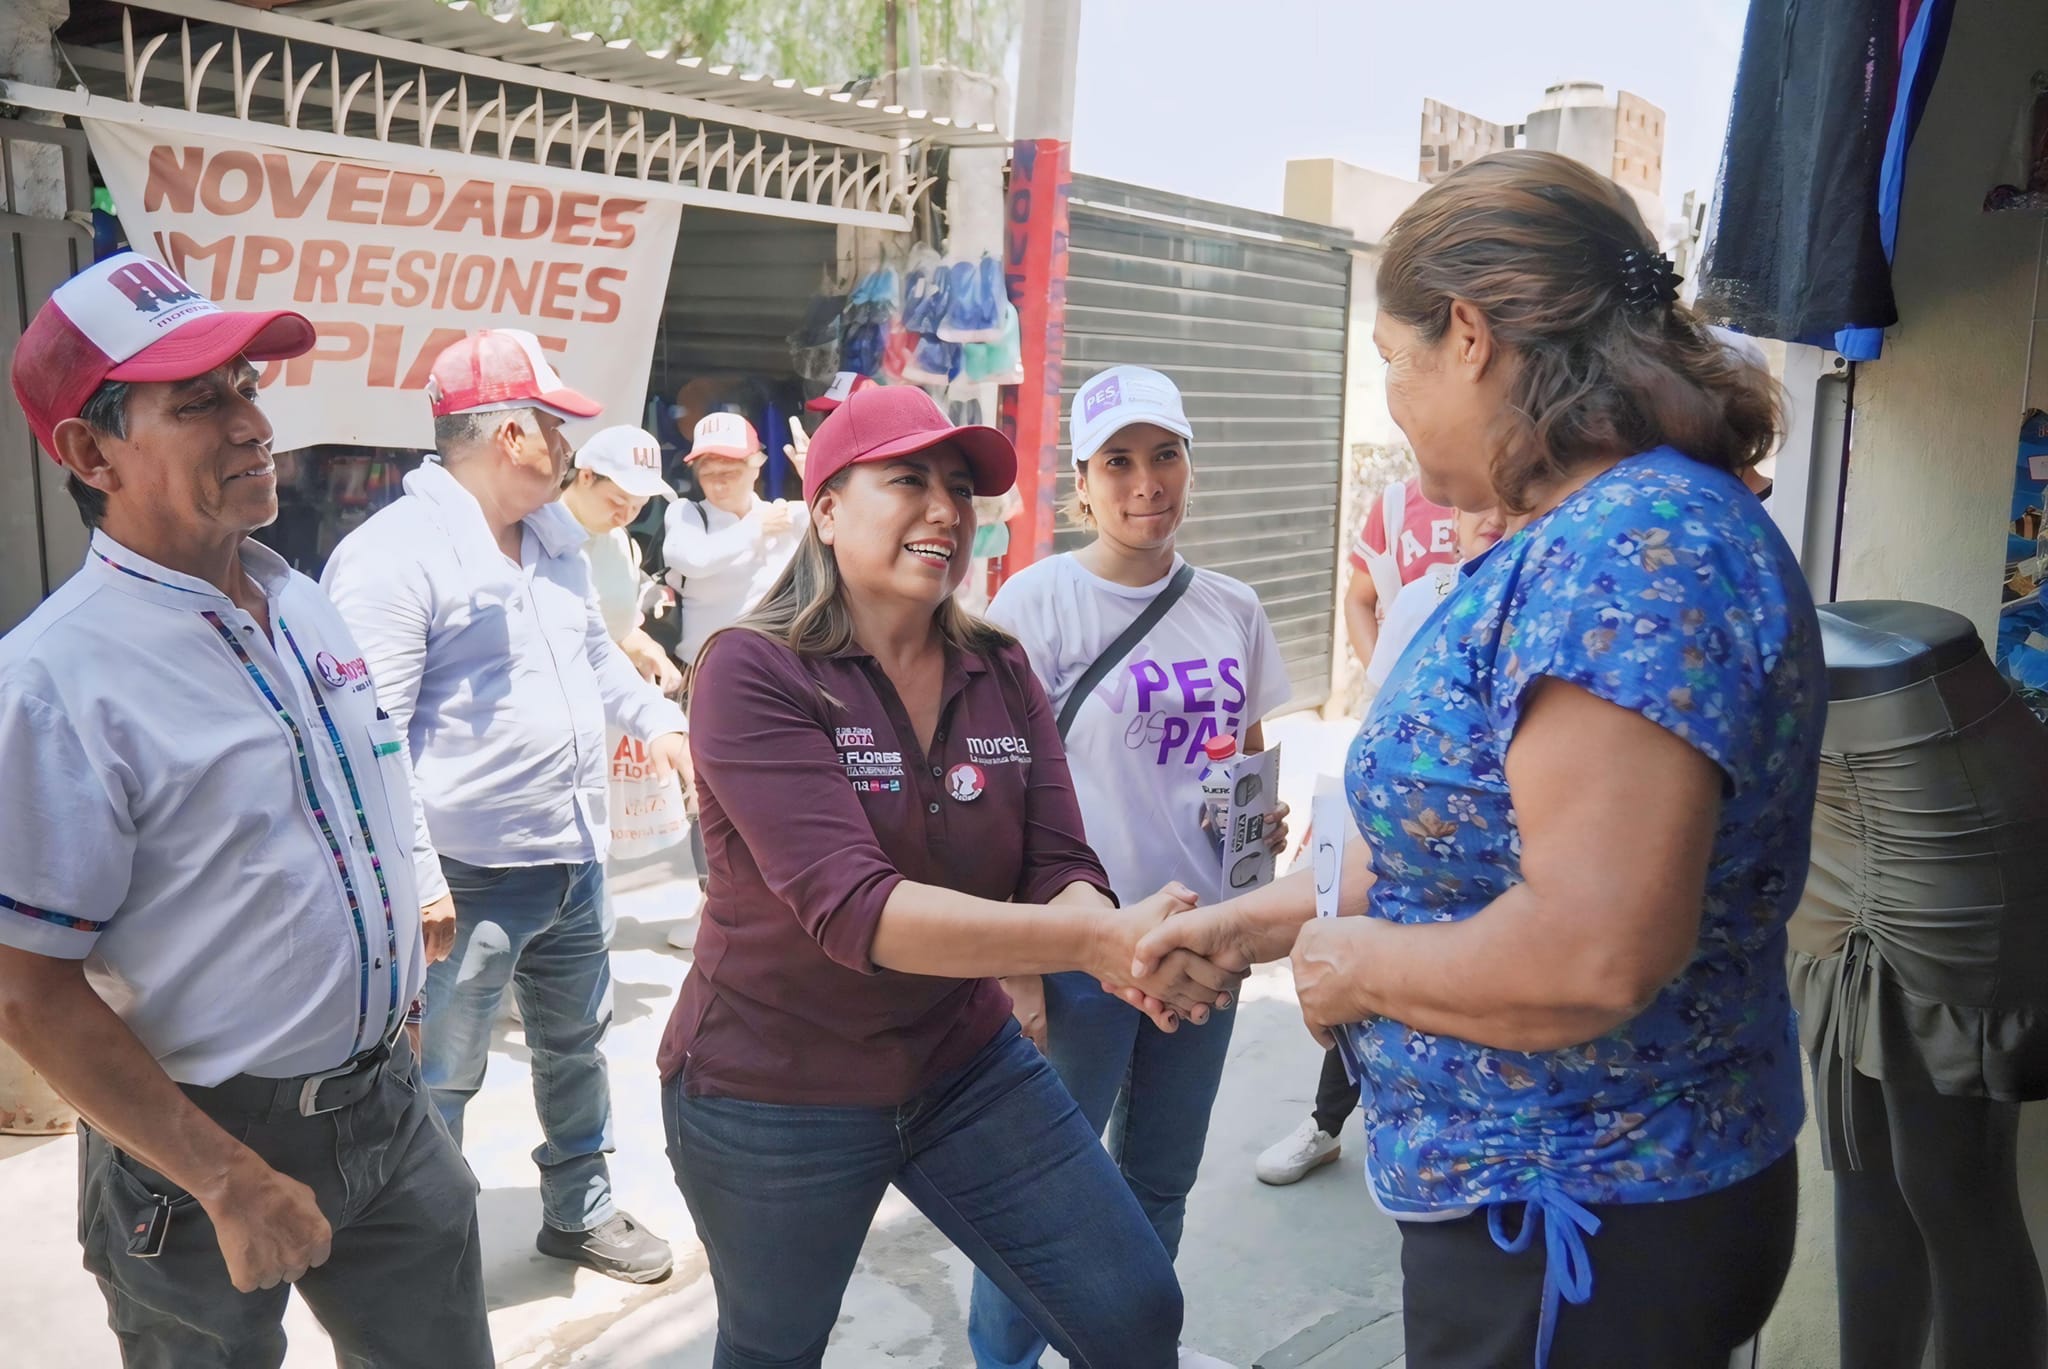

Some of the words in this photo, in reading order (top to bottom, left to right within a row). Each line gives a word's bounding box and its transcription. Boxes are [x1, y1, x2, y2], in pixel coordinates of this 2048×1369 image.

[144, 145, 647, 249] NOVEDADES
[1087, 385, 1116, 411] PES
[1129, 657, 1246, 714] PES
[837, 734, 874, 746] VOTA
[846, 751, 902, 764] FLORES
